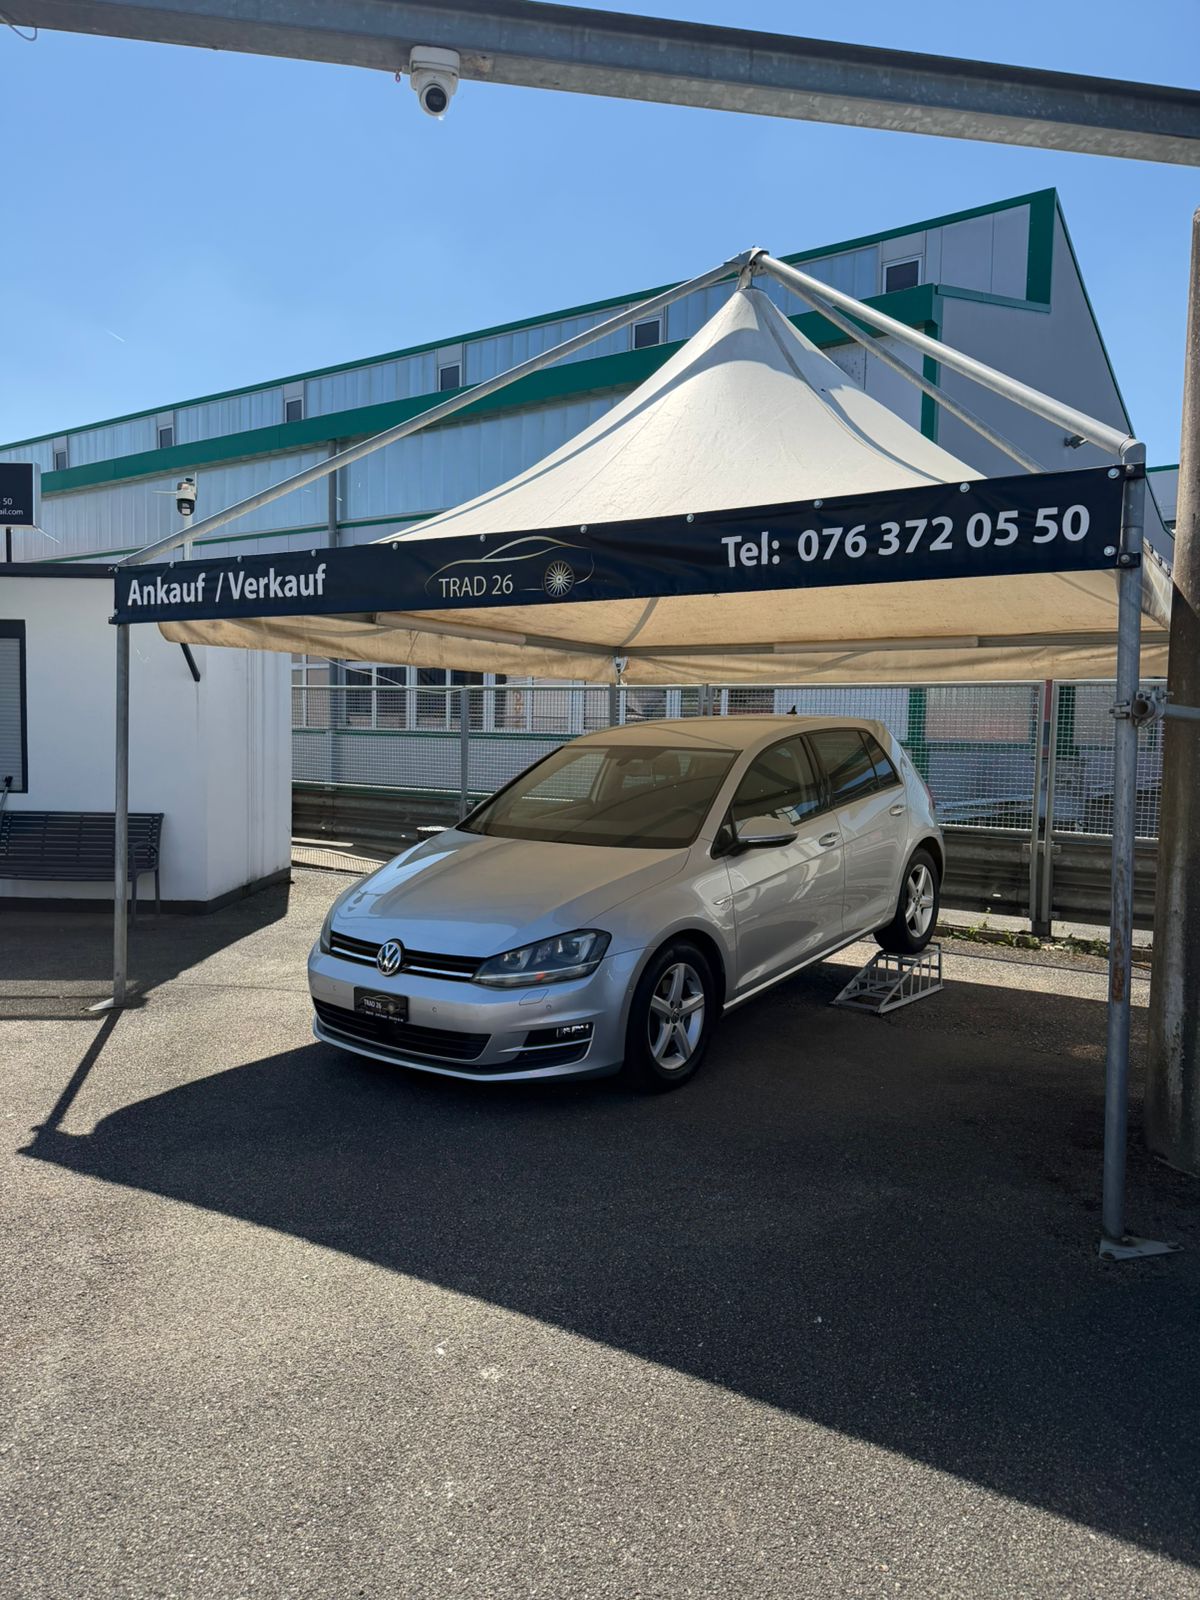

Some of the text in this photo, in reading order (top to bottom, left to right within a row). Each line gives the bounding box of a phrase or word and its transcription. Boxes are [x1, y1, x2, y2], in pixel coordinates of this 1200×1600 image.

[721, 504, 1091, 568] Tel: 076 372 05 50
[127, 572, 206, 606] Ankauf
[438, 574, 514, 599] TRAD 26
